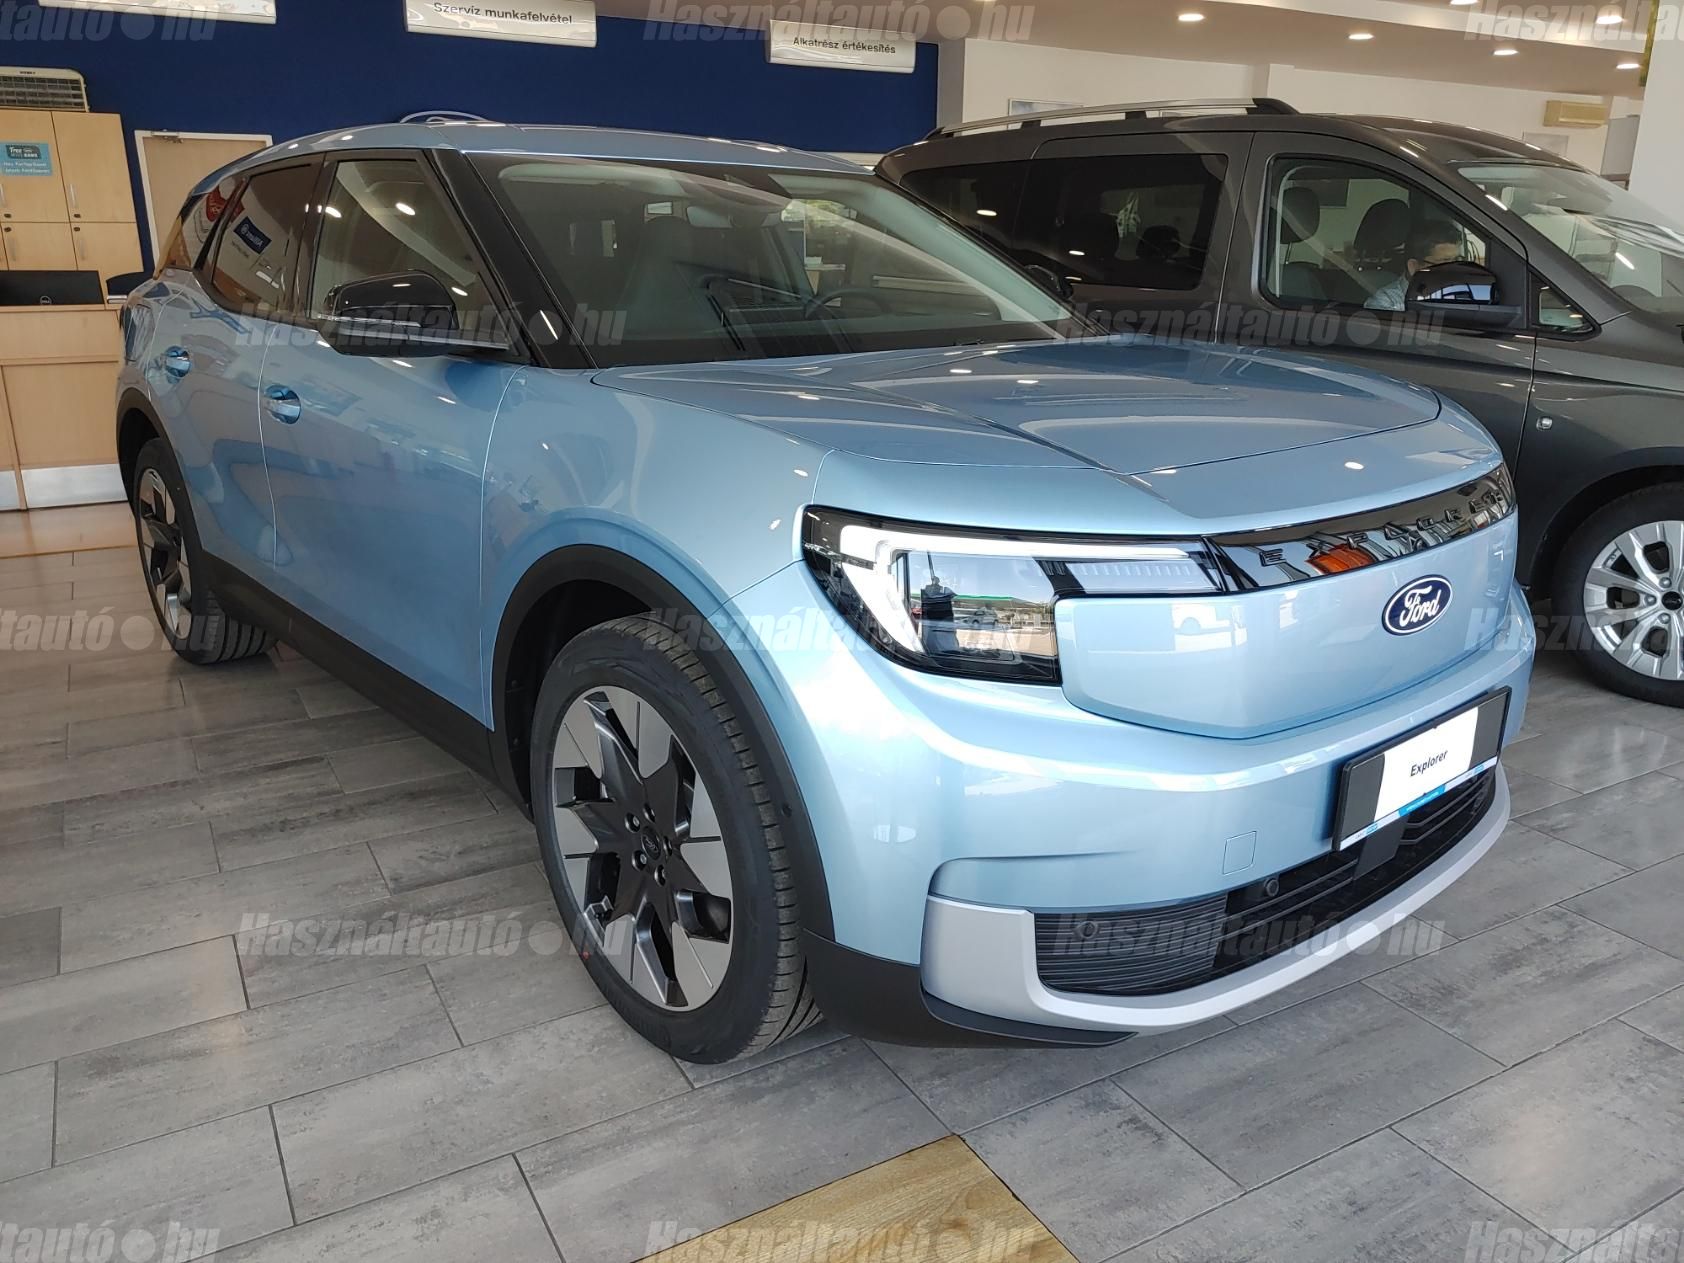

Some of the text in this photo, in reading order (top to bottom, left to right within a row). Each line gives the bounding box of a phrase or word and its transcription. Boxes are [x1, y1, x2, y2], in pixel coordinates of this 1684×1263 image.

[485, 9, 573, 24] munkafelvétel
[793, 37, 896, 53] Alkatrész értékesítés
[1399, 585, 1442, 627] Ford
[1410, 750, 1449, 777] Explorer
